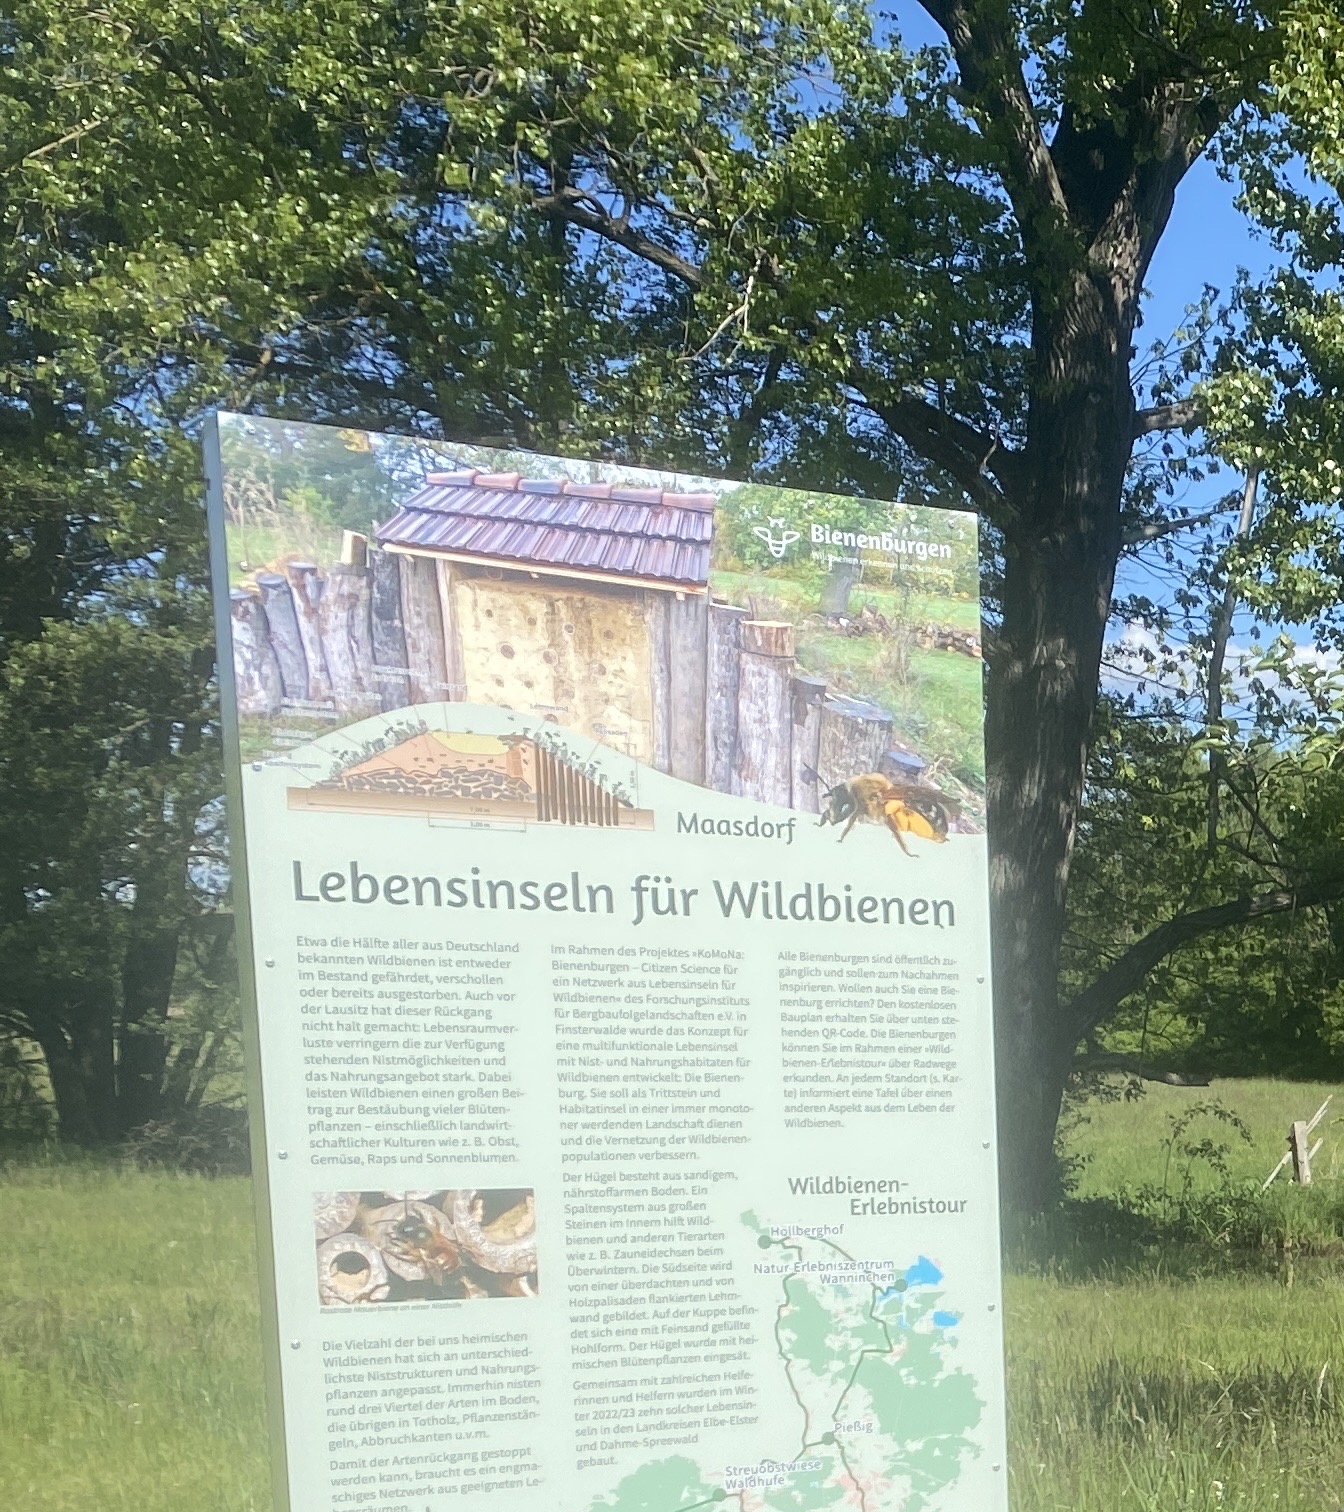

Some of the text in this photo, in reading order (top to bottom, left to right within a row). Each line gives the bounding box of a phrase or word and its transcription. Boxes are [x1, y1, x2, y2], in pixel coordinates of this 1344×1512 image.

[811, 524, 951, 560] Bienenburgen
[676, 811, 796, 846] Maasdorf
[290, 860, 957, 930] Lebensinseln für Wildbienen
[296, 934, 519, 953] Etwa die Hälfte aller aus Deutschland
[550, 942, 565, 954] Im
[567, 943, 615, 956] Rahmen
[616, 944, 636, 956] des
[638, 945, 690, 960] Projektes
[297, 951, 512, 968] bekannten Wildbienen ist entweder
[297, 968, 315, 981] im
[317, 969, 368, 982] Bestand
[435, 971, 504, 984] verschollen
[551, 975, 736, 990] ein Netzwerk aus Lebensinseln für
[298, 986, 329, 998] oder
[330, 986, 374, 999] bereits
[464, 989, 494, 1001] Auch
[496, 992, 517, 1001] vor
[300, 1002, 493, 1020] der Lausitz hat dieser Rückgang
[301, 1019, 334, 1031] nicht
[336, 1020, 361, 1032] halt
[554, 1023, 749, 1039] Finsterwalde wurde das Konzept für
[303, 1053, 506, 1068] stehenden Nistmöglichkeiten und
[304, 1070, 328, 1082] das
[330, 1070, 440, 1085] Nahrungsangebot
[477, 1070, 512, 1082] Dabei
[306, 1103, 333, 1118] trag
[334, 1106, 355, 1115] zur
[357, 1102, 430, 1118] Bestäubung
[431, 1102, 466, 1114] vieler
[559, 1117, 742, 1130] ner werdenden Landschaft dienen
[562, 1171, 582, 1182] Der
[584, 1170, 616, 1185] Hügel
[619, 1169, 660, 1181] besteht
[662, 1172, 681, 1180] aus
[788, 1175, 909, 1195] Wildbienen-
[562, 1185, 648, 1198] nährstoffarmen
[691, 1184, 708, 1195] Ein
[850, 1197, 968, 1216] Erlebnistour
[820, 1272, 895, 1284] Wanninchen
[322, 1329, 528, 1352] Die Vielzahl der bei uns heimischen
[322, 1352, 392, 1368] Wildbienen
[394, 1351, 414, 1364] hat
[416, 1350, 441, 1362] sich
[443, 1352, 458, 1361] an
[324, 1370, 365, 1384] lichste
[366, 1365, 452, 1382] Niststrukturen
[455, 1364, 478, 1376] und
[572, 1375, 638, 1390] Gemeinsam
[639, 1374, 658, 1386] mit
[660, 1370, 721, 1385] zahlreichen
[326, 1403, 356, 1417] rund
[357, 1402, 382, 1415] drei
[383, 1399, 423, 1413] Viertel
[424, 1398, 445, 1410] der
[446, 1395, 479, 1409] Arten
[481, 1394, 497, 1406] im
[574, 1409, 590, 1421] ter
[591, 1406, 635, 1420] 2022/23
[637, 1404, 663, 1417] zehn
[665, 1401, 704, 1415] solcher
[834, 1422, 873, 1434] Pießig
[329, 1444, 531, 1471] Damit der Artenrückgang gestoppt
[725, 1461, 821, 1476] Streuobstwiese
[725, 1474, 785, 1489] Waldhufe
